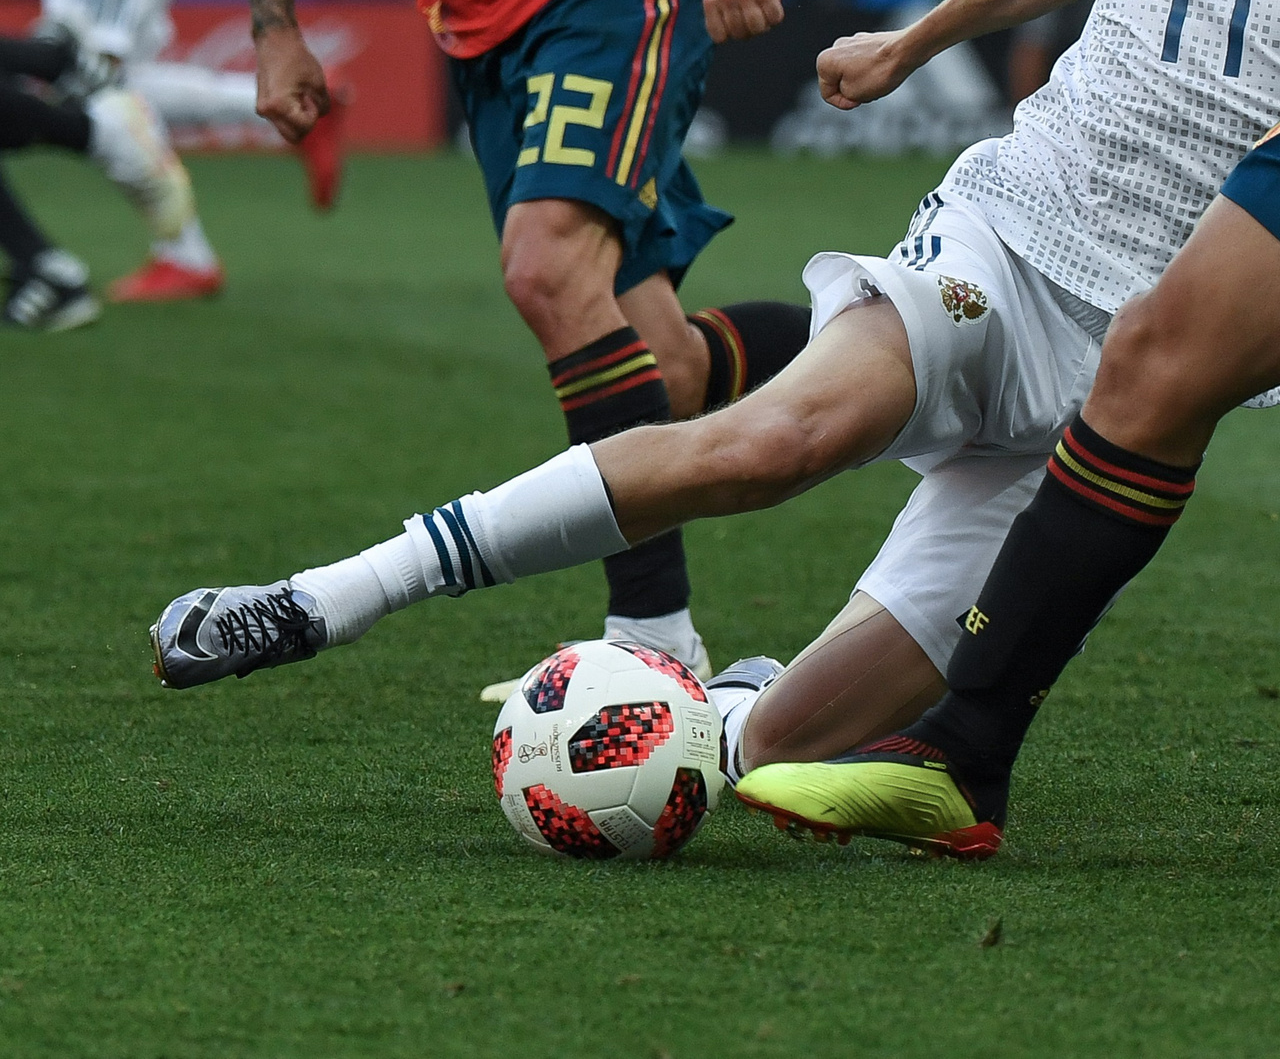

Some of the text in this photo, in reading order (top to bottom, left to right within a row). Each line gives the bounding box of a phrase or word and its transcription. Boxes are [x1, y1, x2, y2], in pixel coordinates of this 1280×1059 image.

[516, 72, 614, 168] 22
[692, 727, 698, 739] 5
[599, 819, 630, 850] TELSTAR
